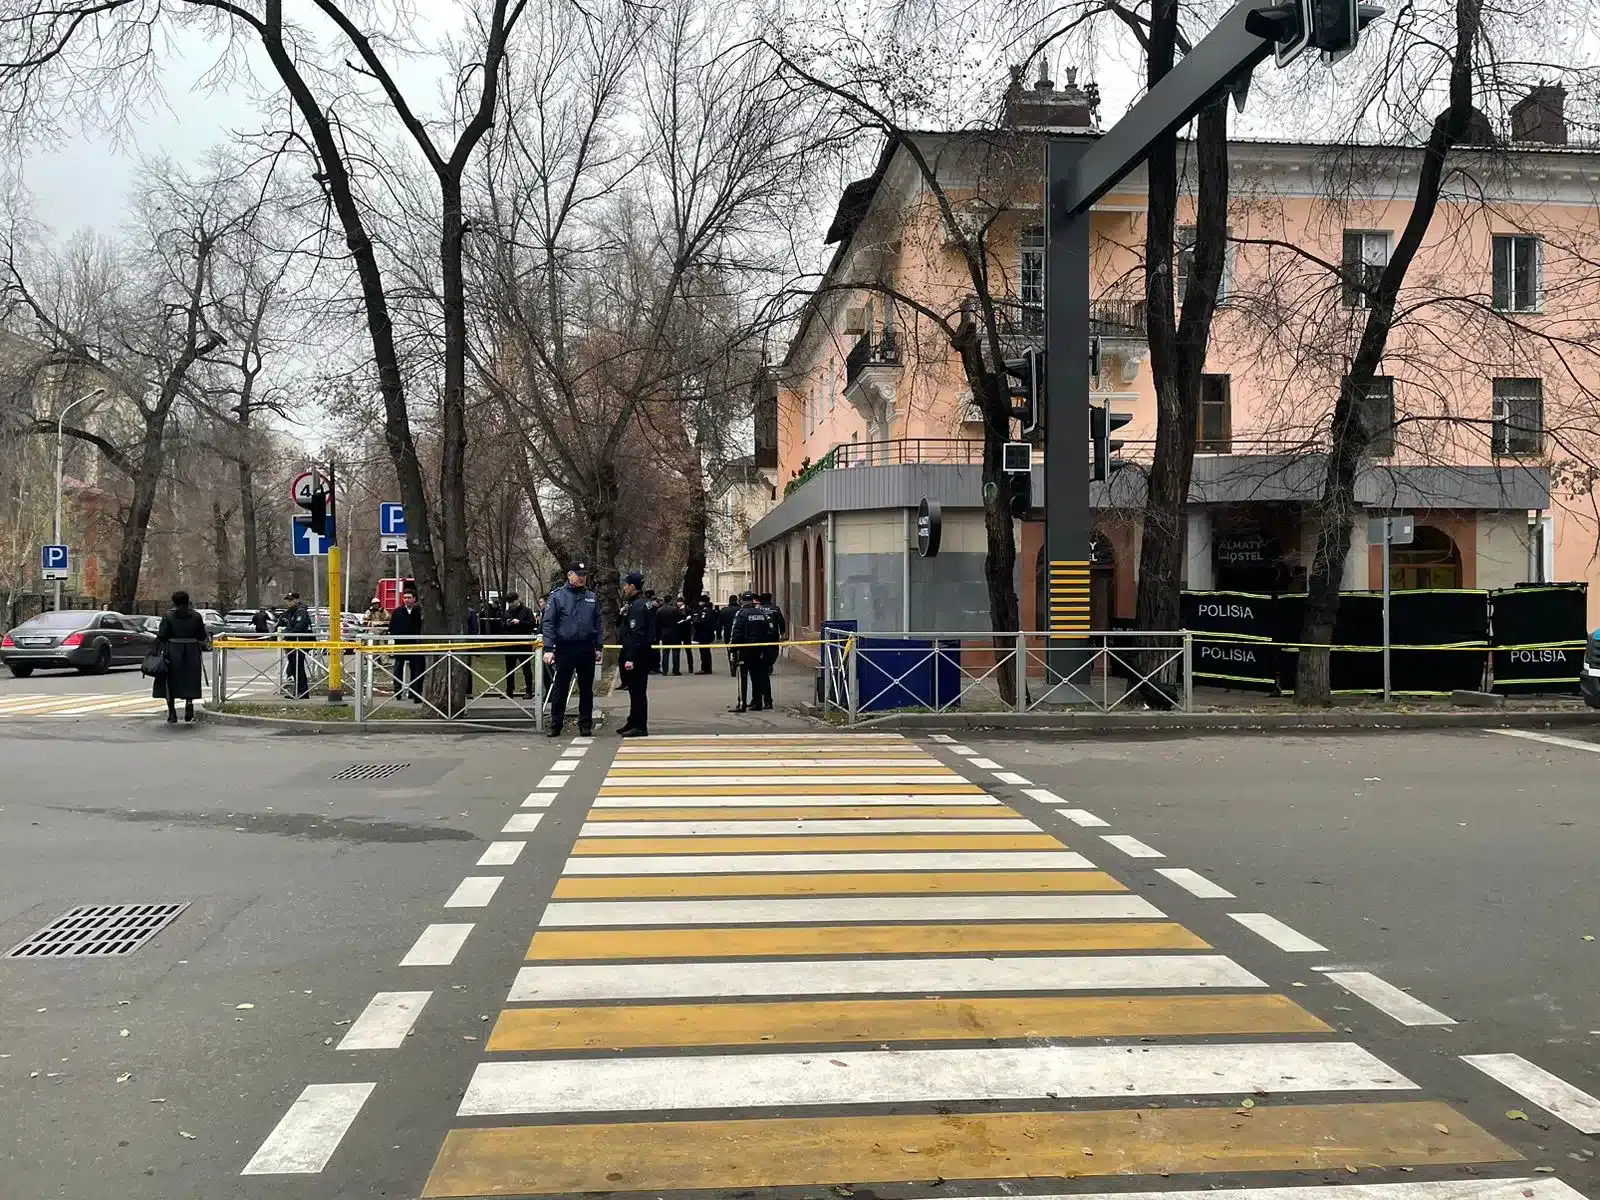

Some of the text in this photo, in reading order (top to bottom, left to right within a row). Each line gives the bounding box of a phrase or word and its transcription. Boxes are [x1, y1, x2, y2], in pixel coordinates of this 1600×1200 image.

[389, 505, 405, 532] P
[1219, 540, 1263, 550] ALMATY
[48, 547, 64, 567] P
[1219, 551, 1264, 561] HOSTEL
[1198, 604, 1254, 619] POLISIA
[1201, 646, 1256, 662] POLISIA
[1510, 650, 1567, 663] POLISIA
